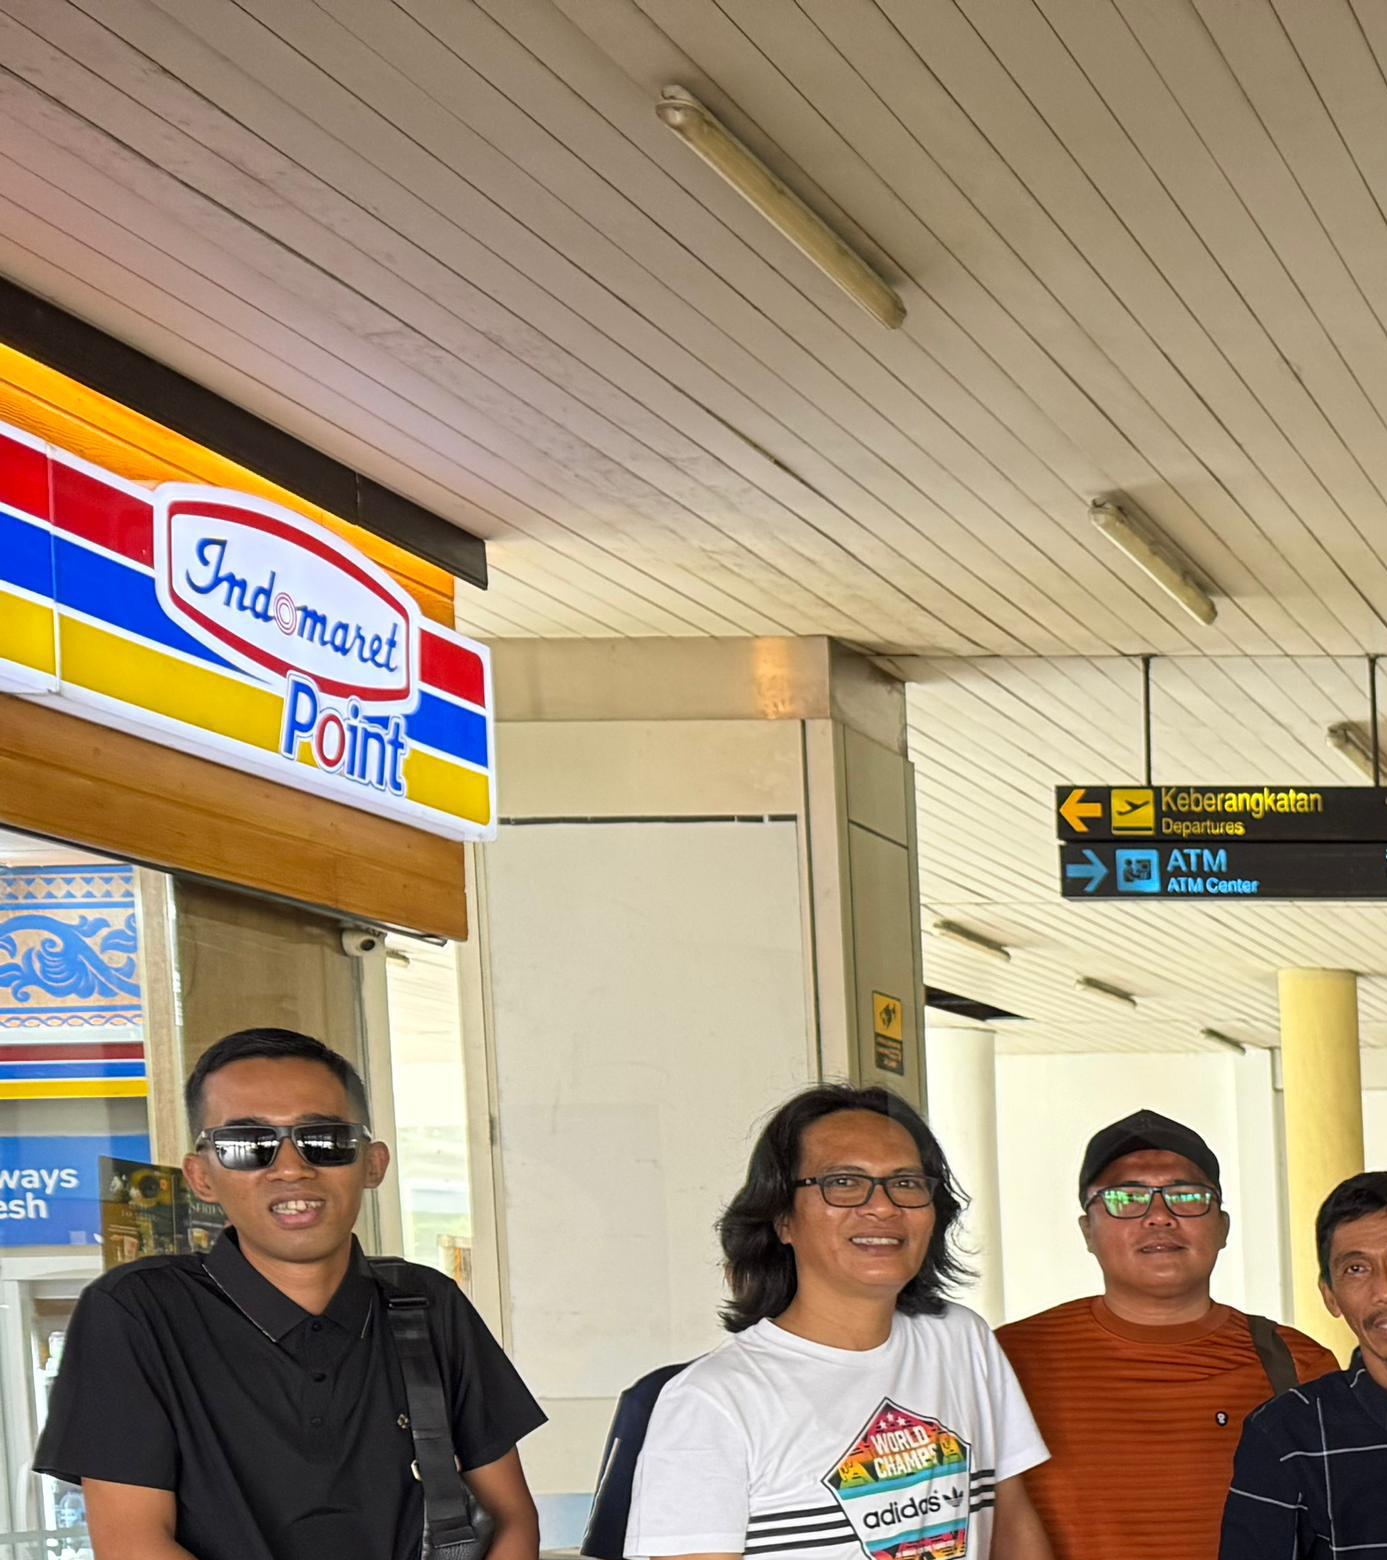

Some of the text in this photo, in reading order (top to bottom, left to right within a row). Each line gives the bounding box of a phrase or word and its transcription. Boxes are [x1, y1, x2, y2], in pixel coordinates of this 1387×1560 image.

[186, 537, 399, 673] Indomaret
[283, 679, 406, 793] Point
[1161, 787, 1324, 817] Keberangkatan
[1162, 818, 1246, 837] Departures
[1167, 848, 1228, 873] ATM
[1167, 876, 1259, 893] ATM Center
[871, 1425, 930, 1456] WORLD
[873, 1443, 938, 1479] CHAMPS
[863, 1495, 941, 1529] adidas
